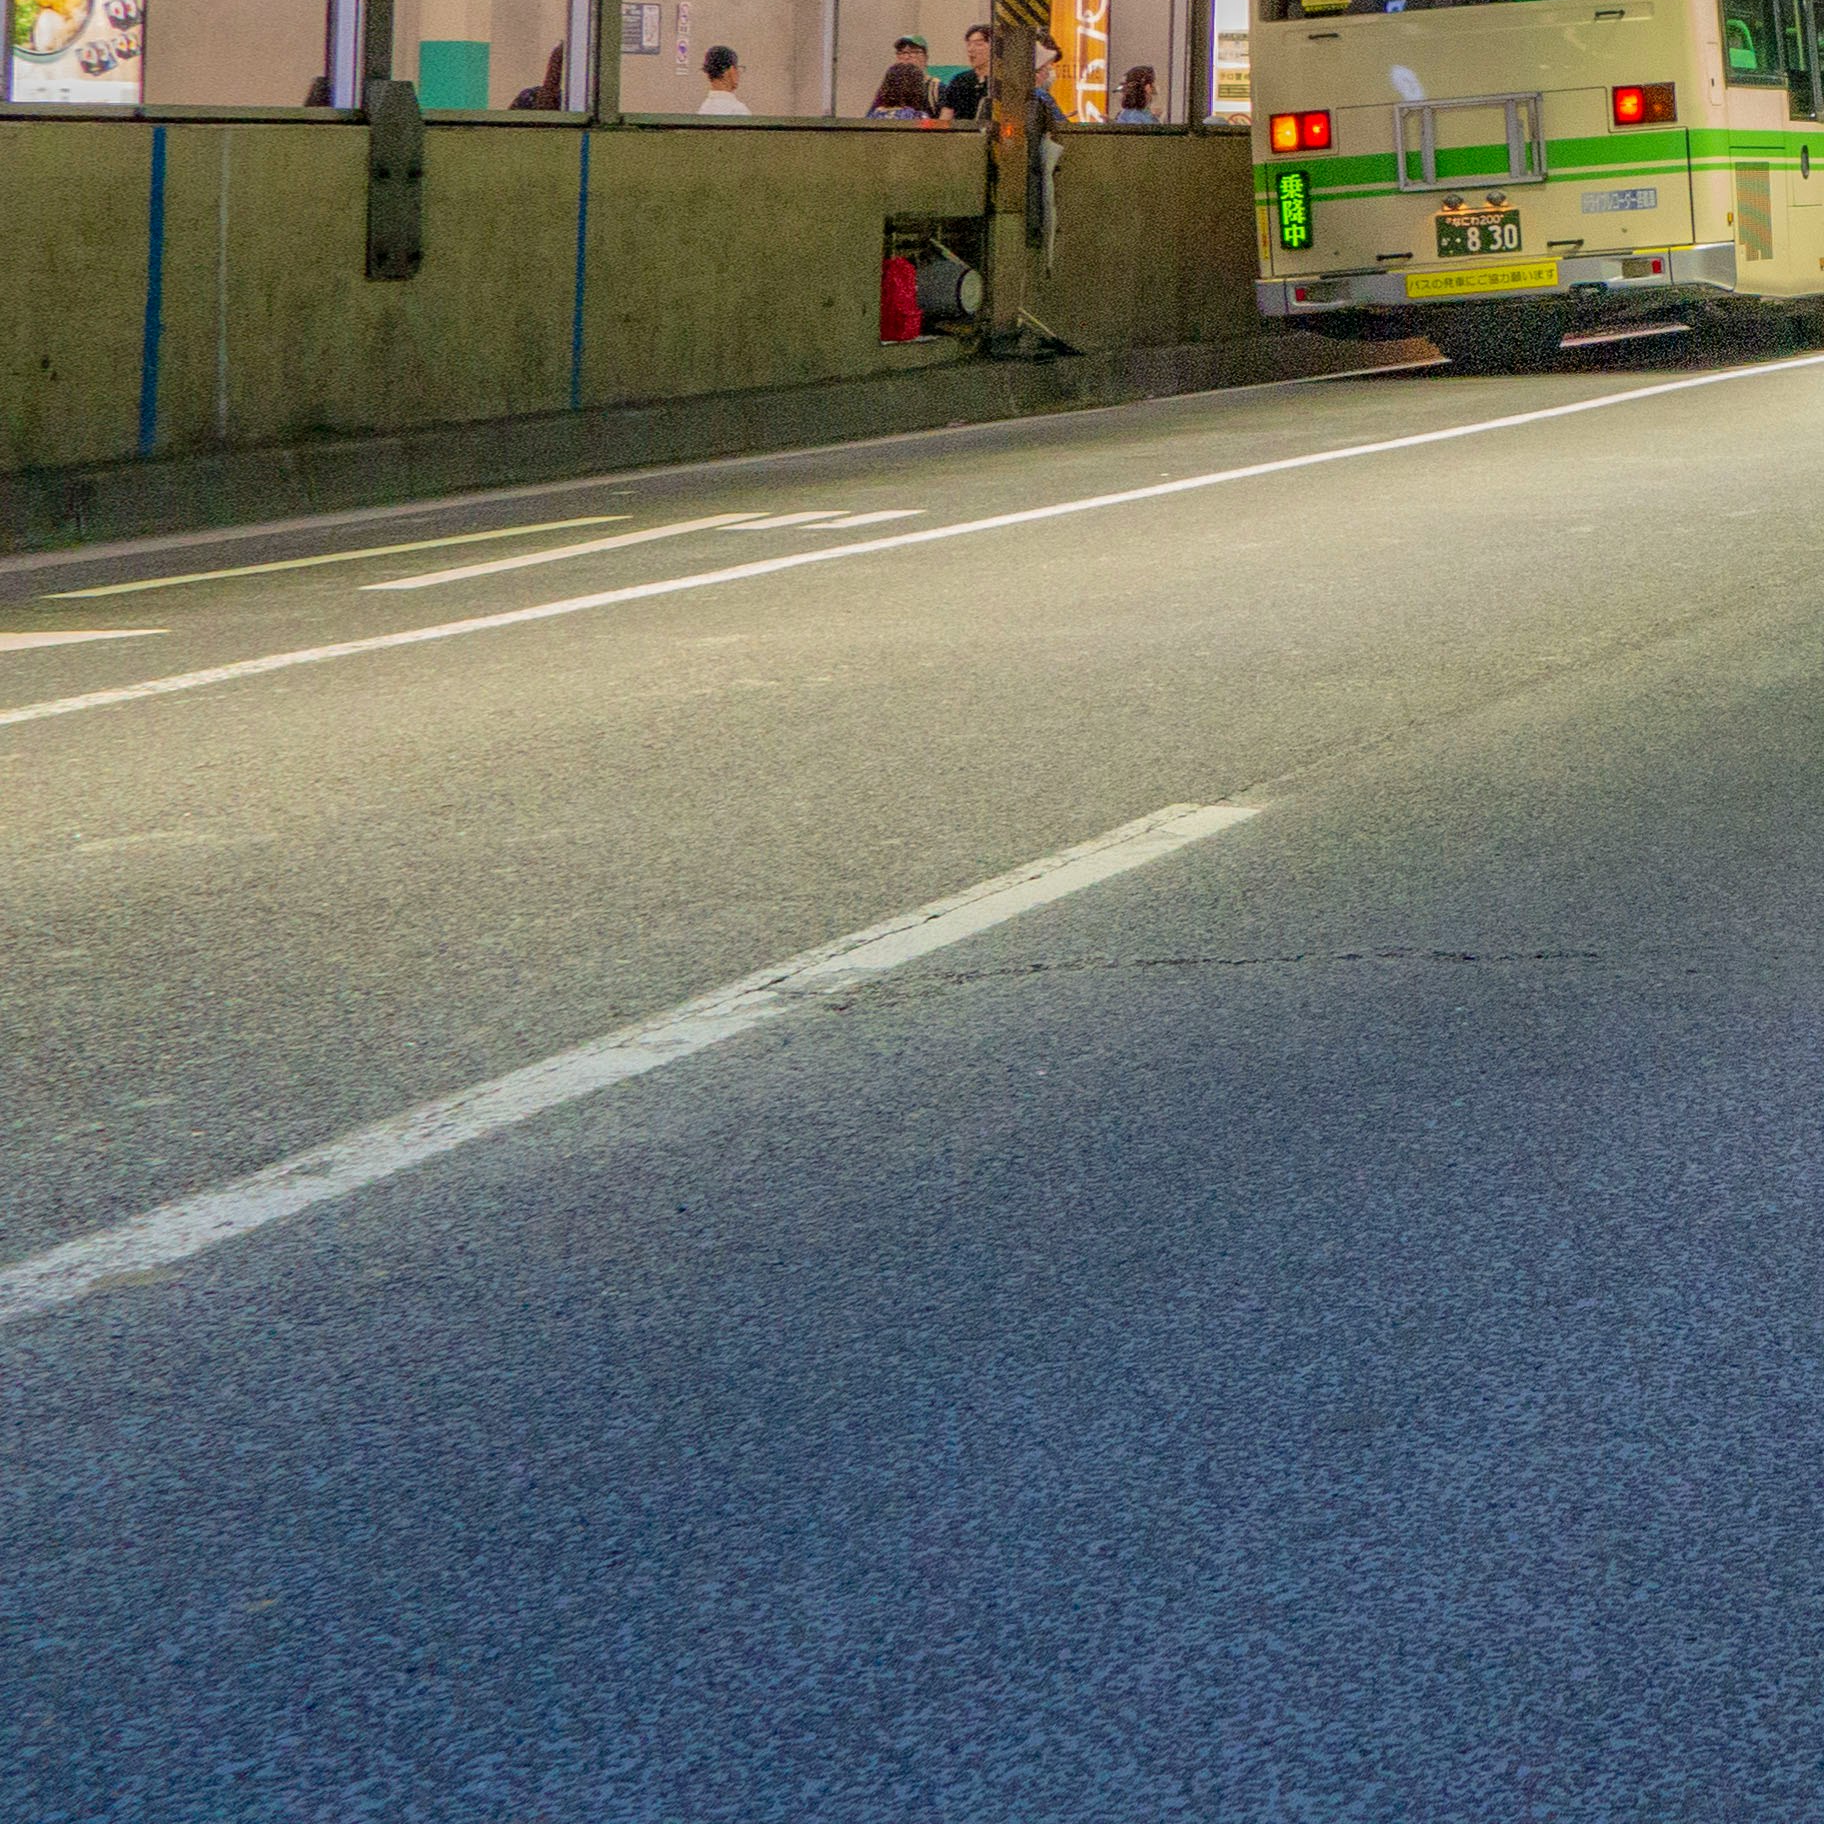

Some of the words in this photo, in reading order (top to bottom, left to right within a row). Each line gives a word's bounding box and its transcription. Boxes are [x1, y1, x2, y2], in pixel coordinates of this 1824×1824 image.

[1279, 174, 1305, 247] 乗降中
[1409, 269, 1555, 290] バスの発車にご協力願います
